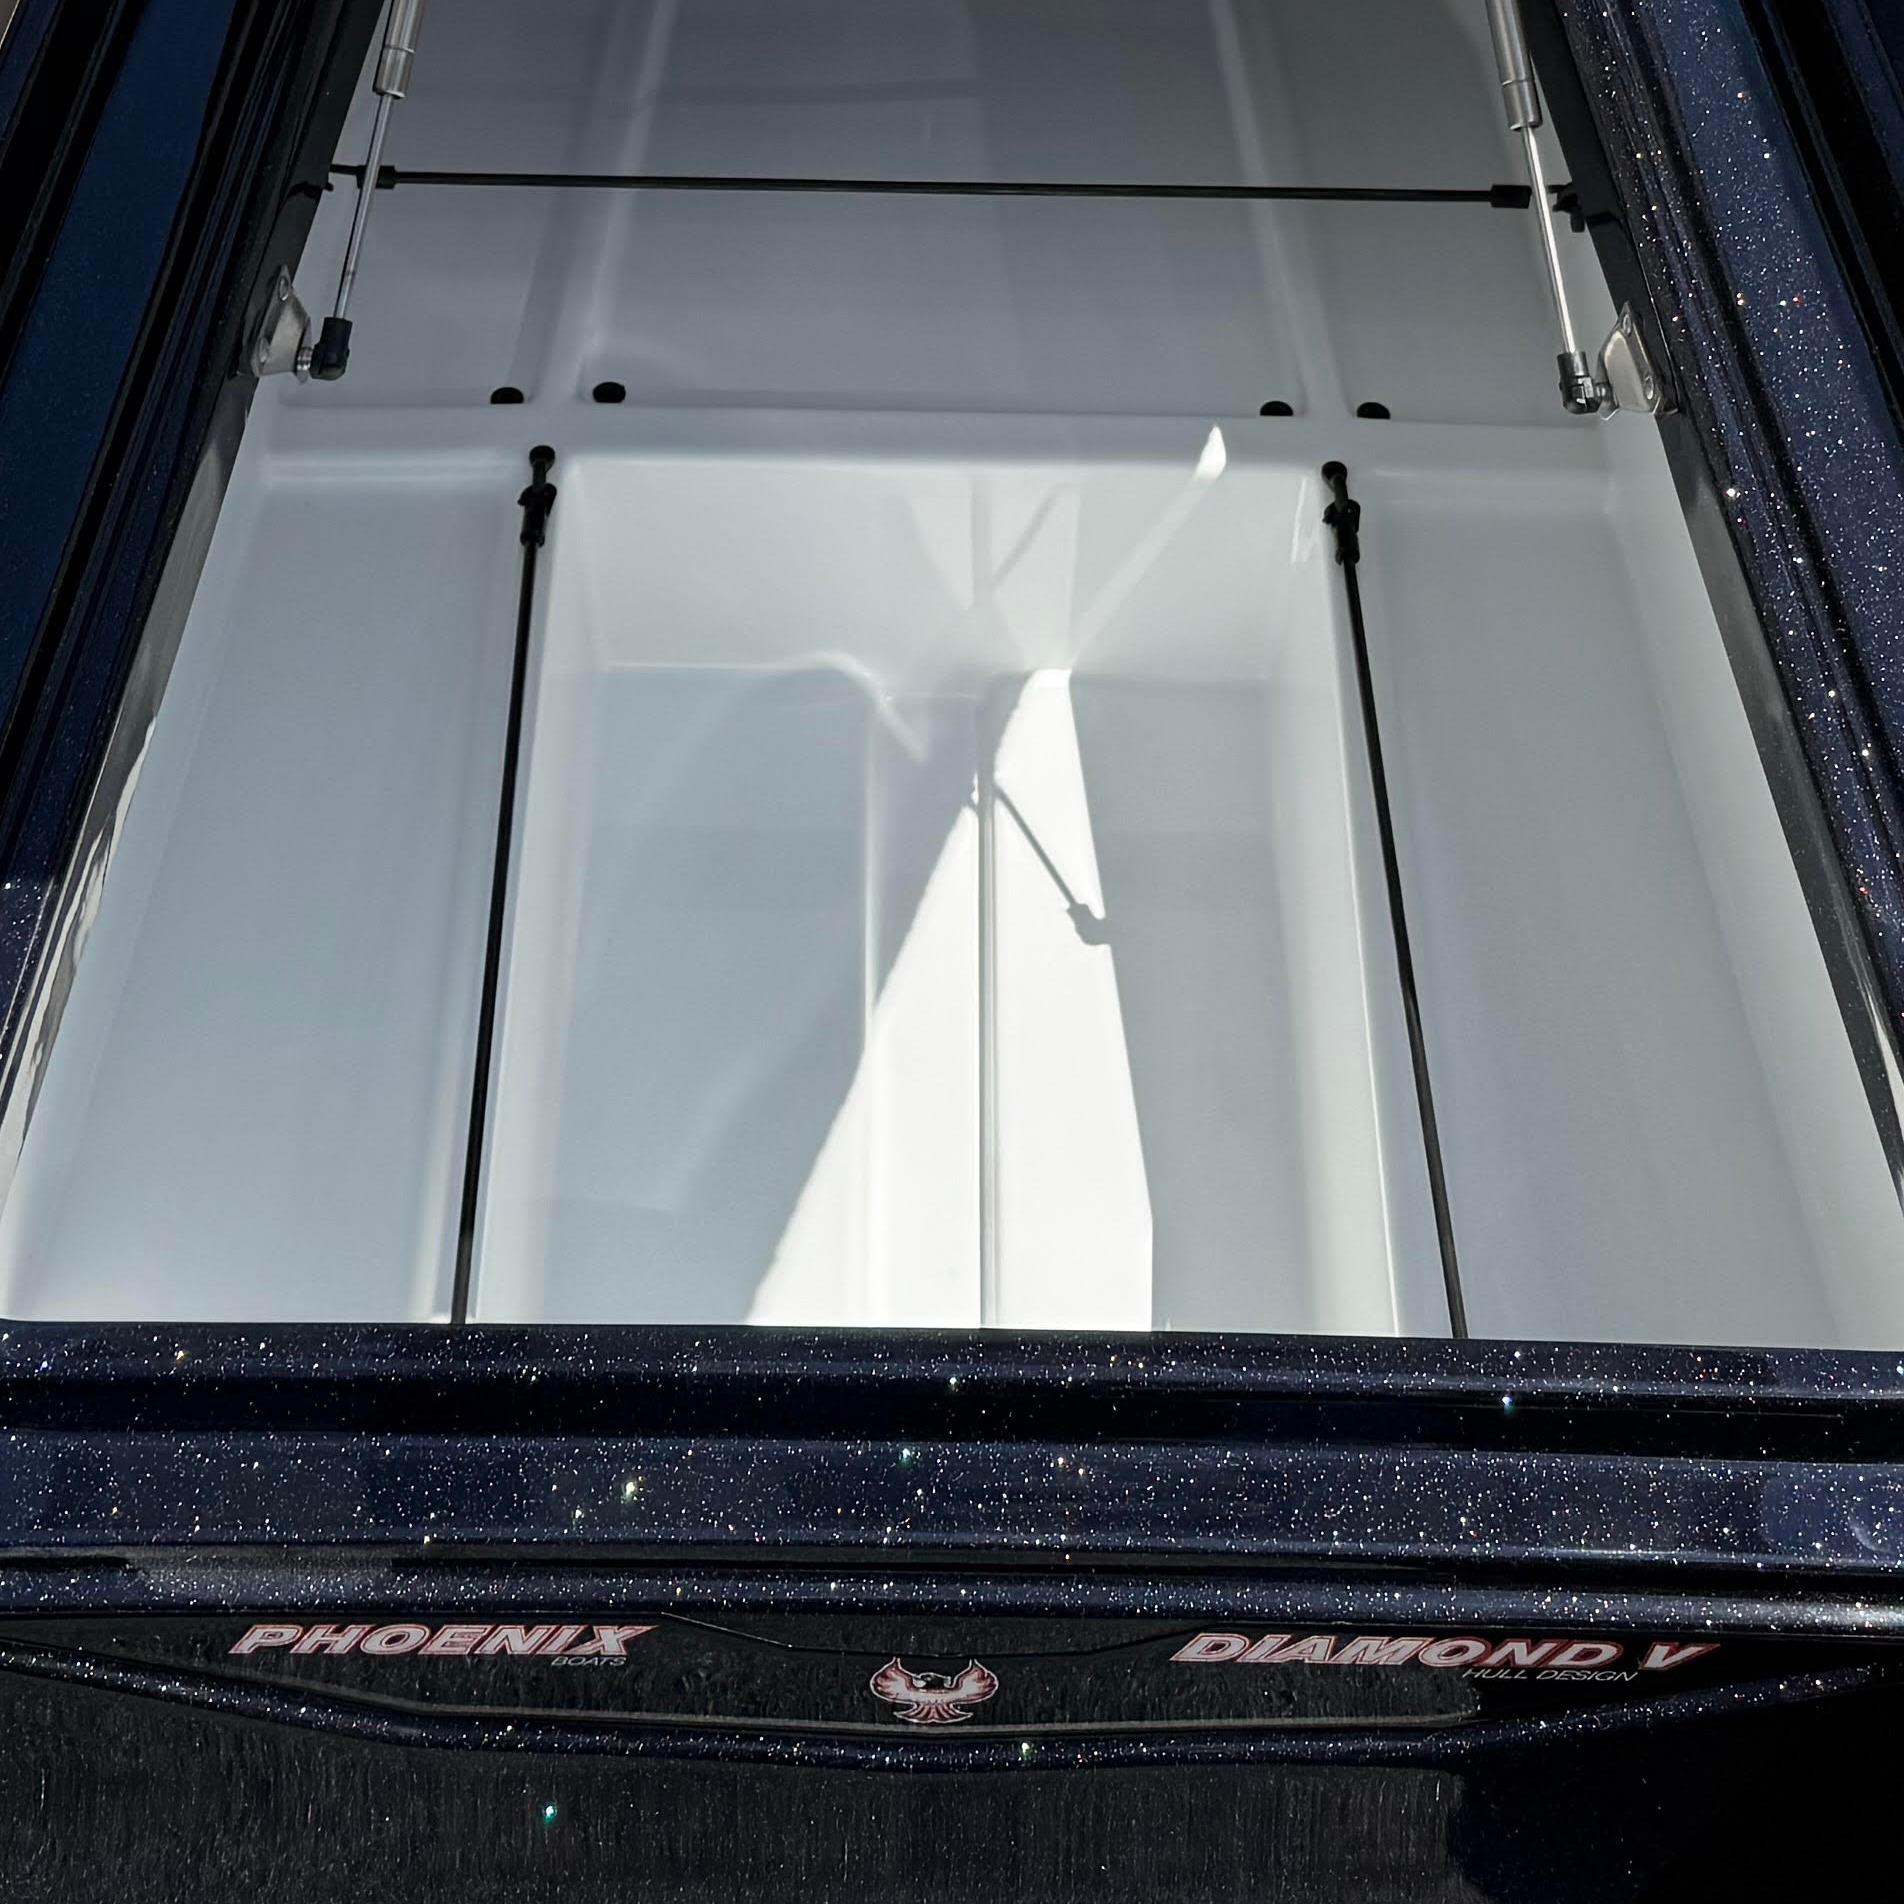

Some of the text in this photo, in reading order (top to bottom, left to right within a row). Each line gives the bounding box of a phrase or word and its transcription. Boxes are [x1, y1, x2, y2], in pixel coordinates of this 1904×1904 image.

[228, 1623, 659, 1655] PHOENIX
[550, 1656, 627, 1667] BOATS
[1169, 1633, 1721, 1671] DIAMOND V
[1461, 1667, 1638, 1683] HULL DESIGN
